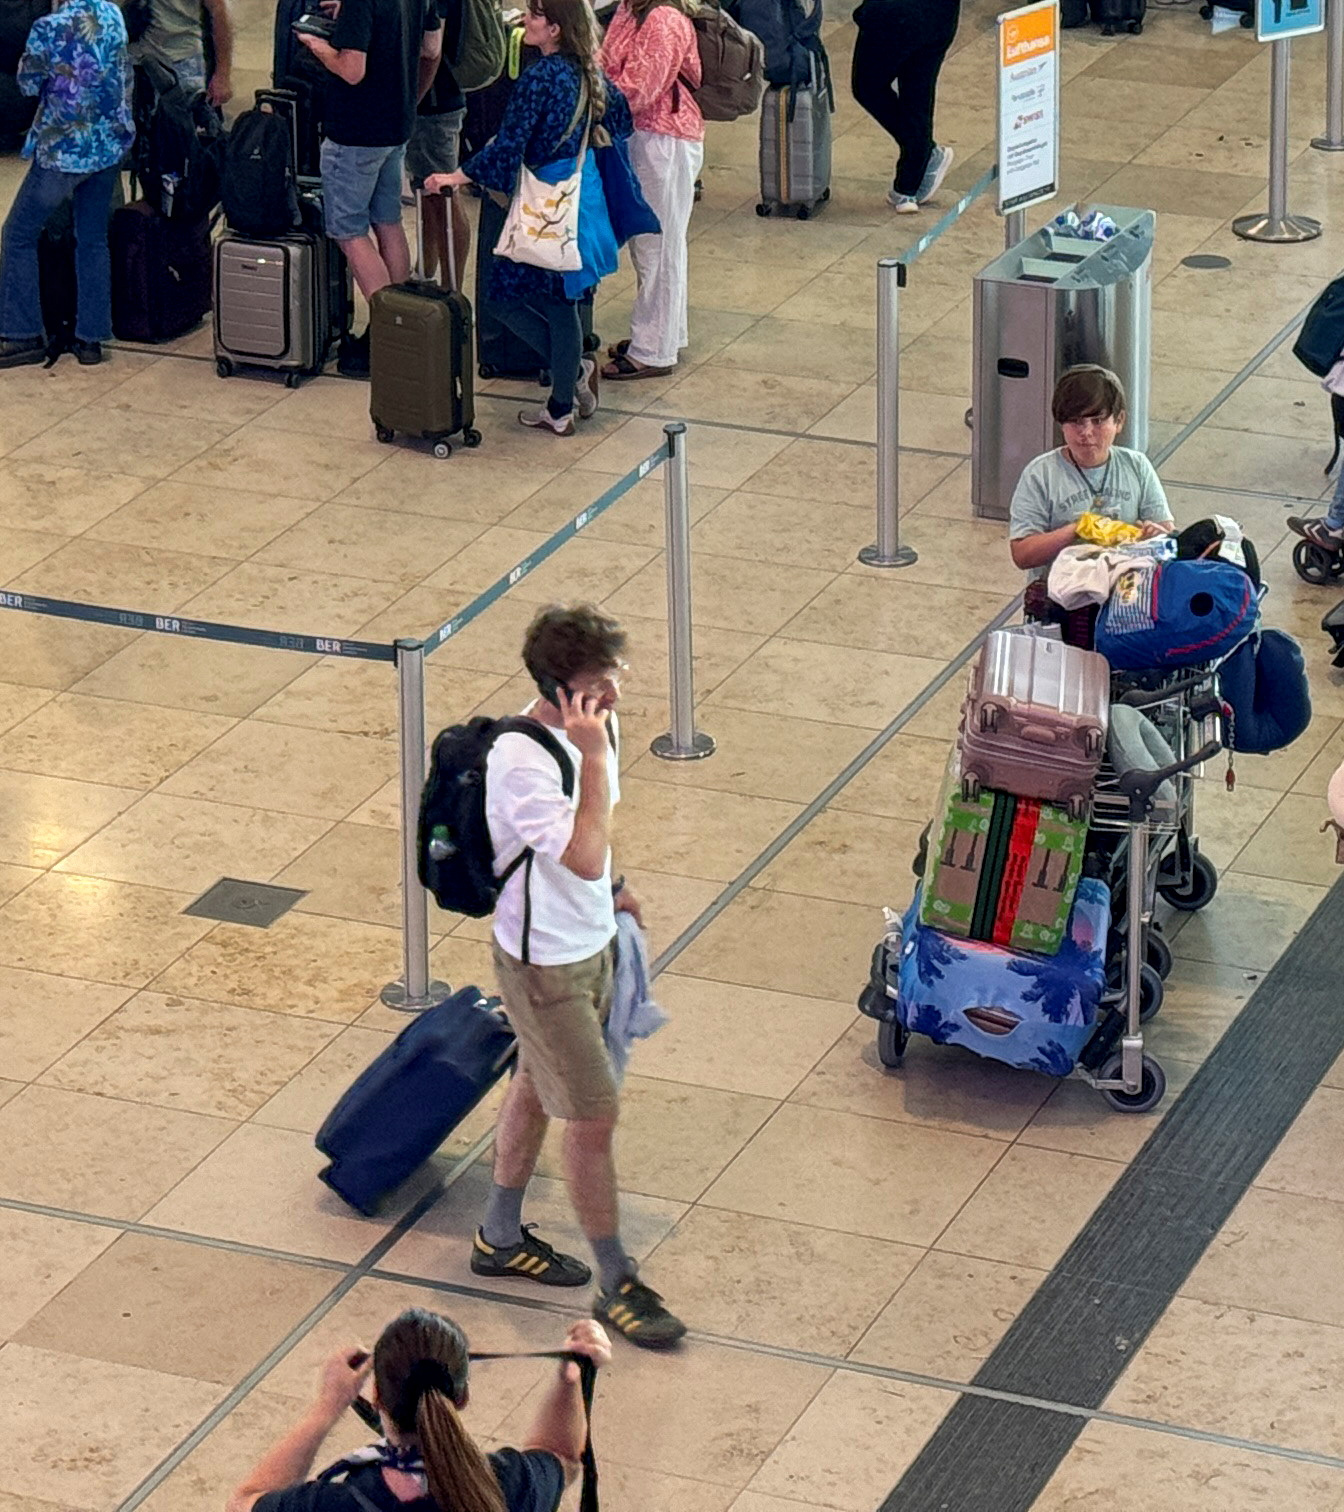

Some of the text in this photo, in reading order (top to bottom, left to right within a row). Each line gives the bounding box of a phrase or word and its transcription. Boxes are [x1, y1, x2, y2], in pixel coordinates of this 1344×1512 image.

[1006, 35, 1051, 59] Lufthansa
[155, 617, 181, 633] BER
[316, 638, 342, 653] BER
